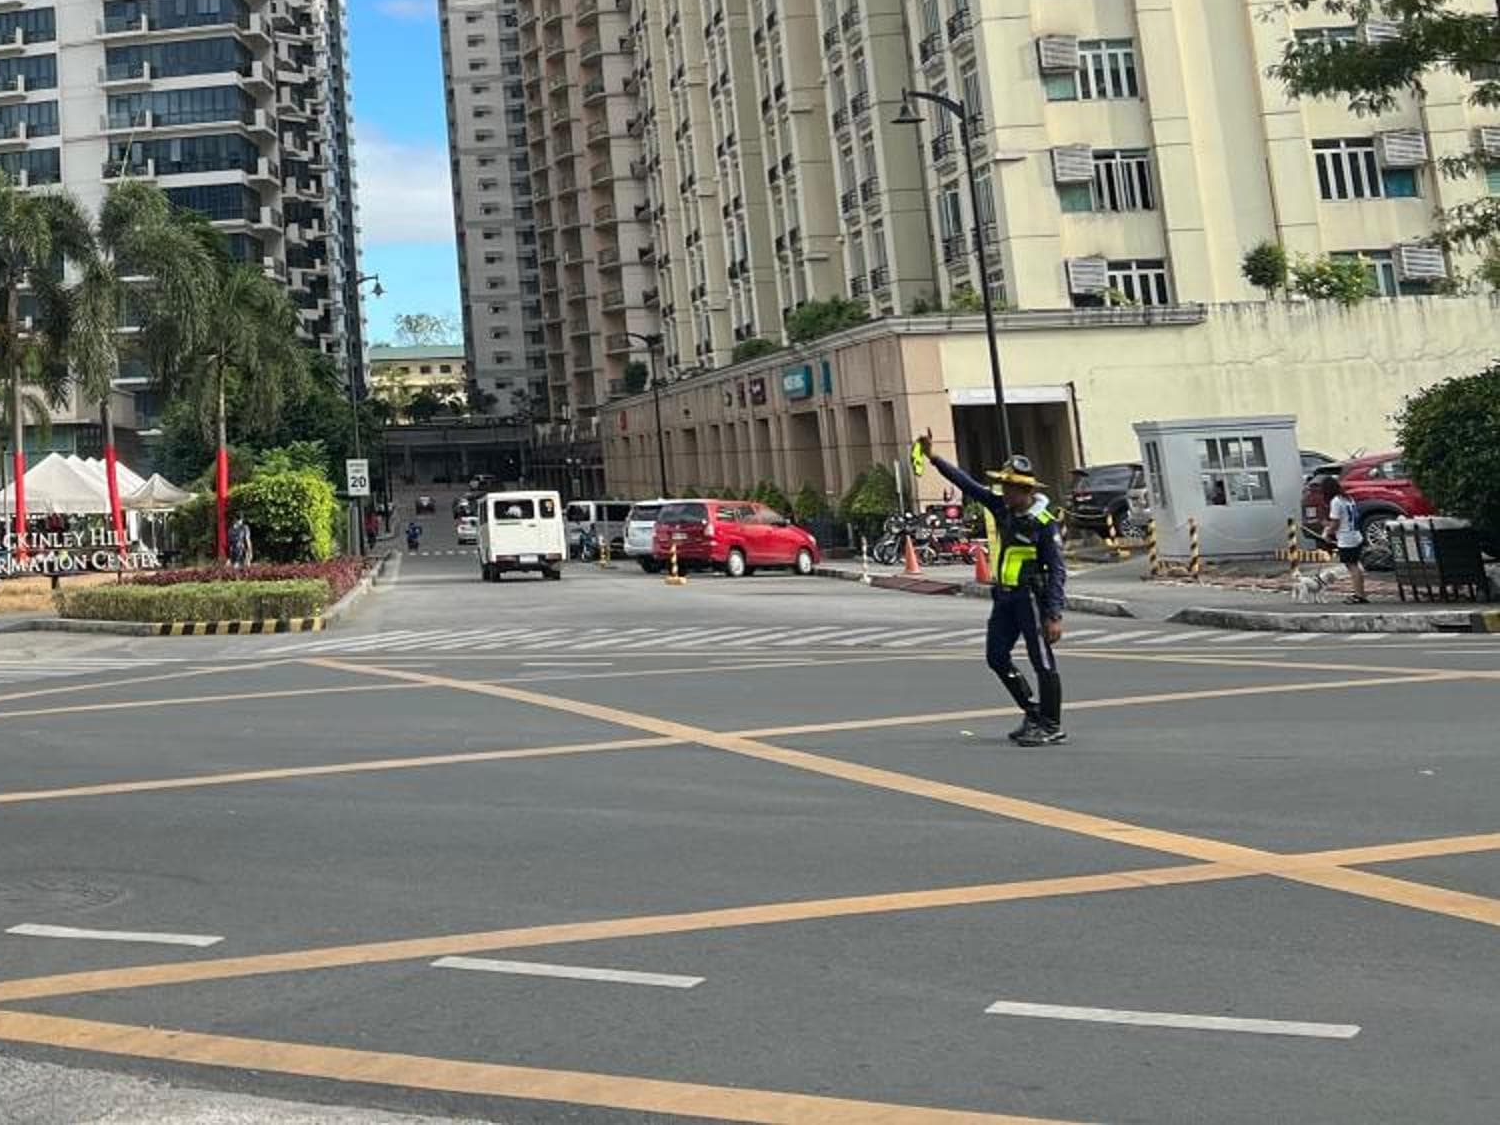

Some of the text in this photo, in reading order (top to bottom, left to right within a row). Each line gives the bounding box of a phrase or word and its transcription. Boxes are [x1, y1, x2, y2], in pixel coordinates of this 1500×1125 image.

[350, 476, 367, 488] 20
[90, 527, 133, 547] HILL
[91, 550, 164, 571] CENTER
